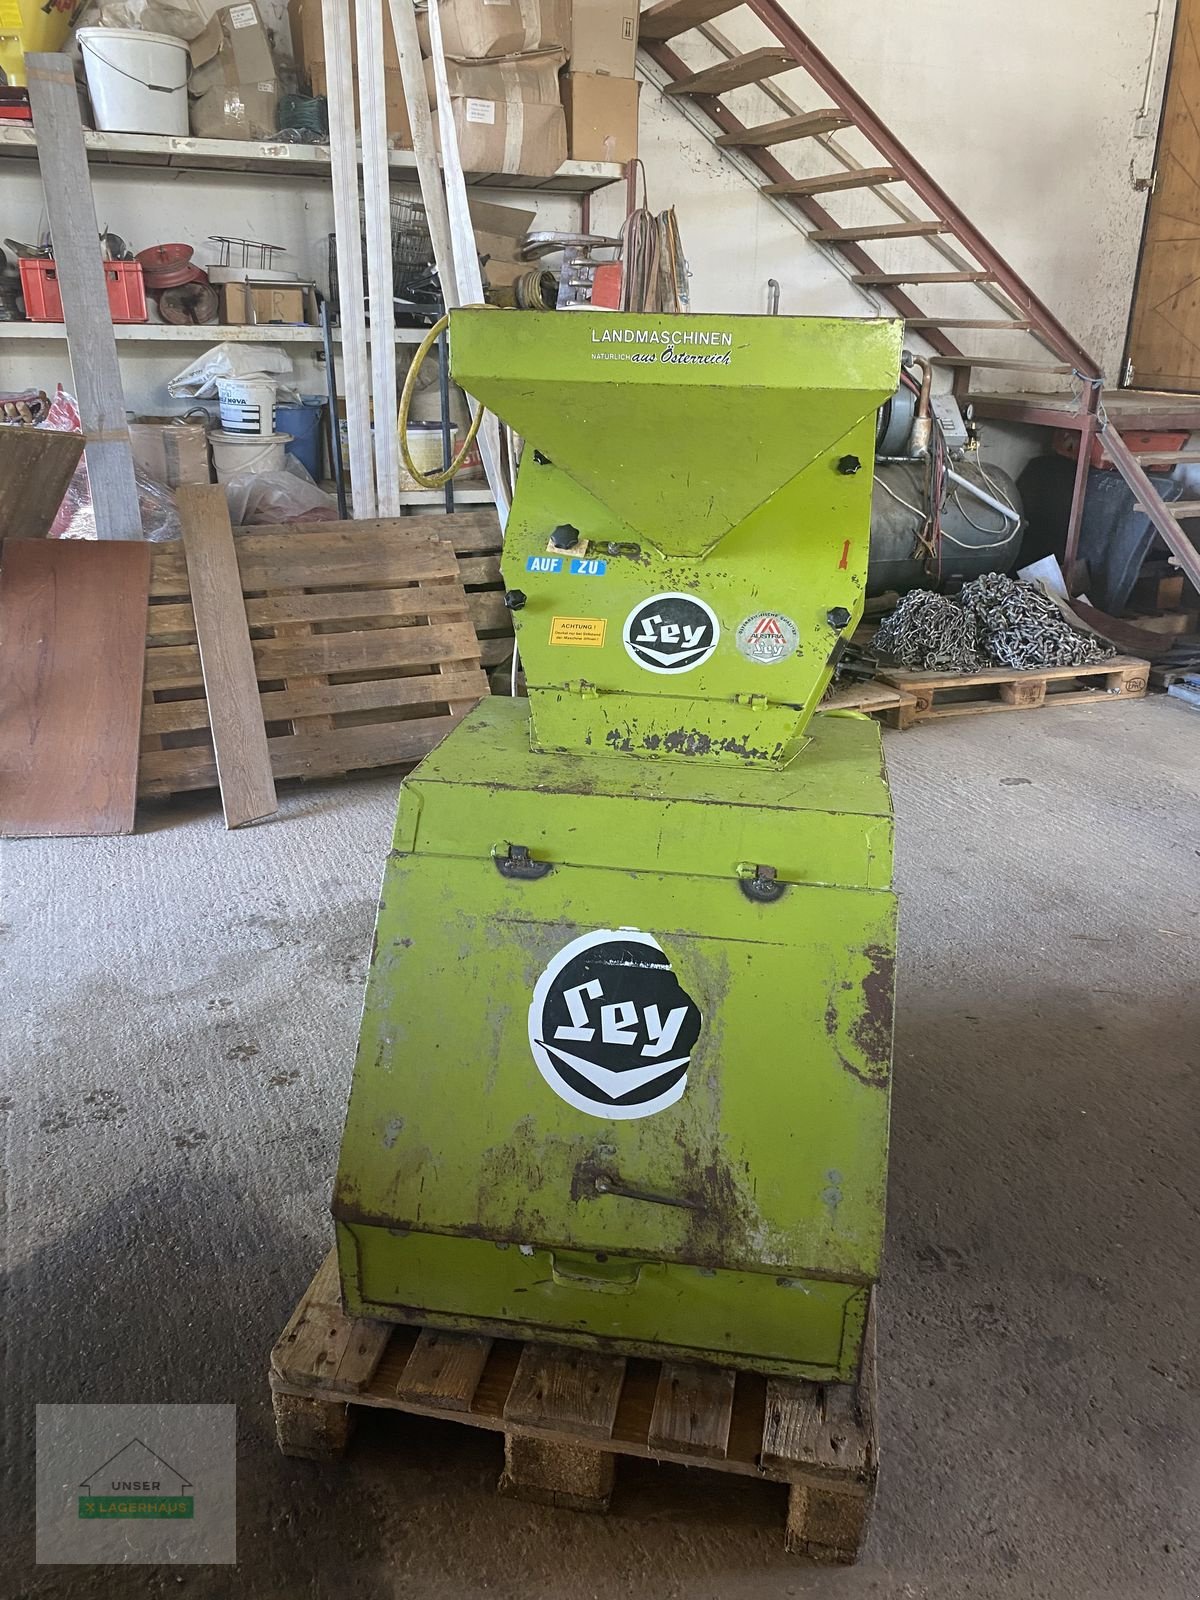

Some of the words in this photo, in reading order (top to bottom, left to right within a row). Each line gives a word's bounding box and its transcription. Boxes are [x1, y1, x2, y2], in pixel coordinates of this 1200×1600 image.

[591, 329, 732, 346] LANDMASCHINEN
[631, 352, 657, 363] aus
[660, 344, 732, 365] Österreich
[530, 557, 559, 572] AUF
[577, 560, 599, 574] ZU
[554, 978, 688, 1057] Sey
